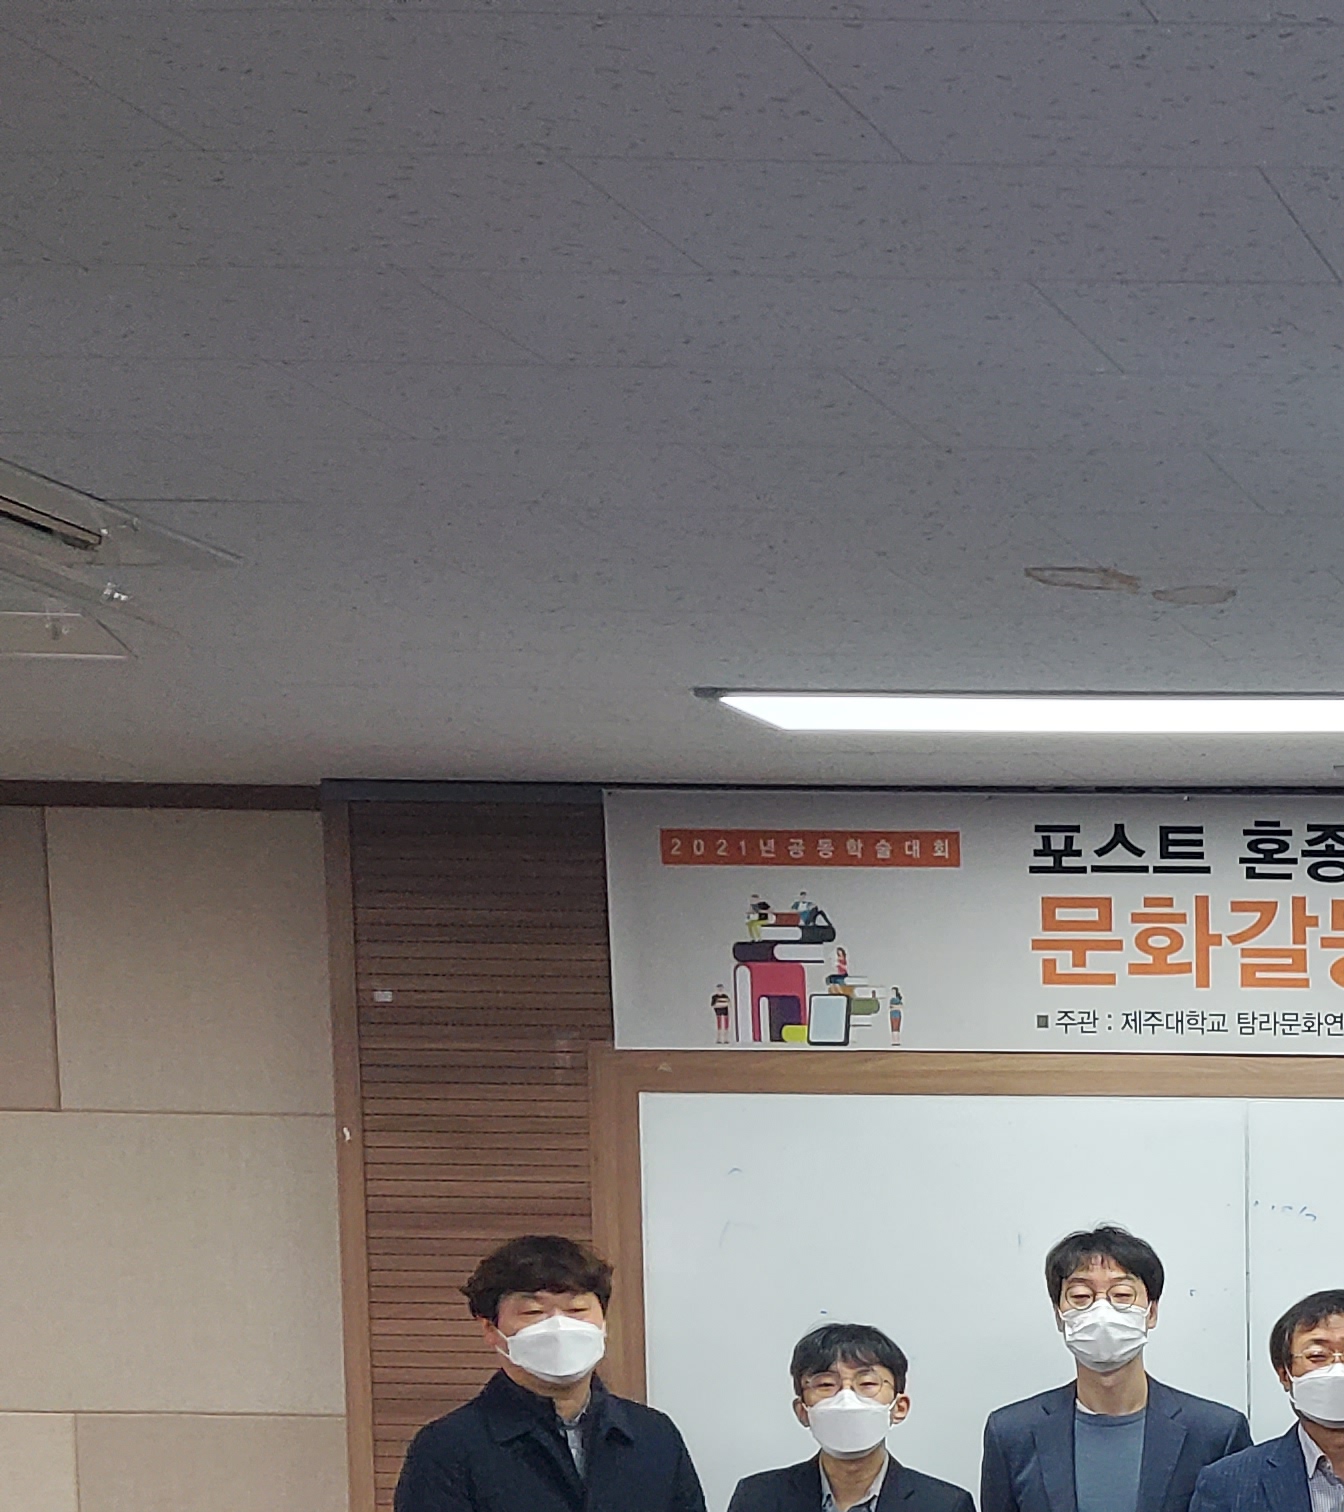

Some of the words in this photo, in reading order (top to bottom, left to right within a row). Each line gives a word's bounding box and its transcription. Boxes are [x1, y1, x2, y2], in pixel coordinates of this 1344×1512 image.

[1028, 822, 1212, 875] 포스트
[1055, 1009, 1100, 1035] 주관
[1120, 1009, 1229, 1036] 제주대학교
